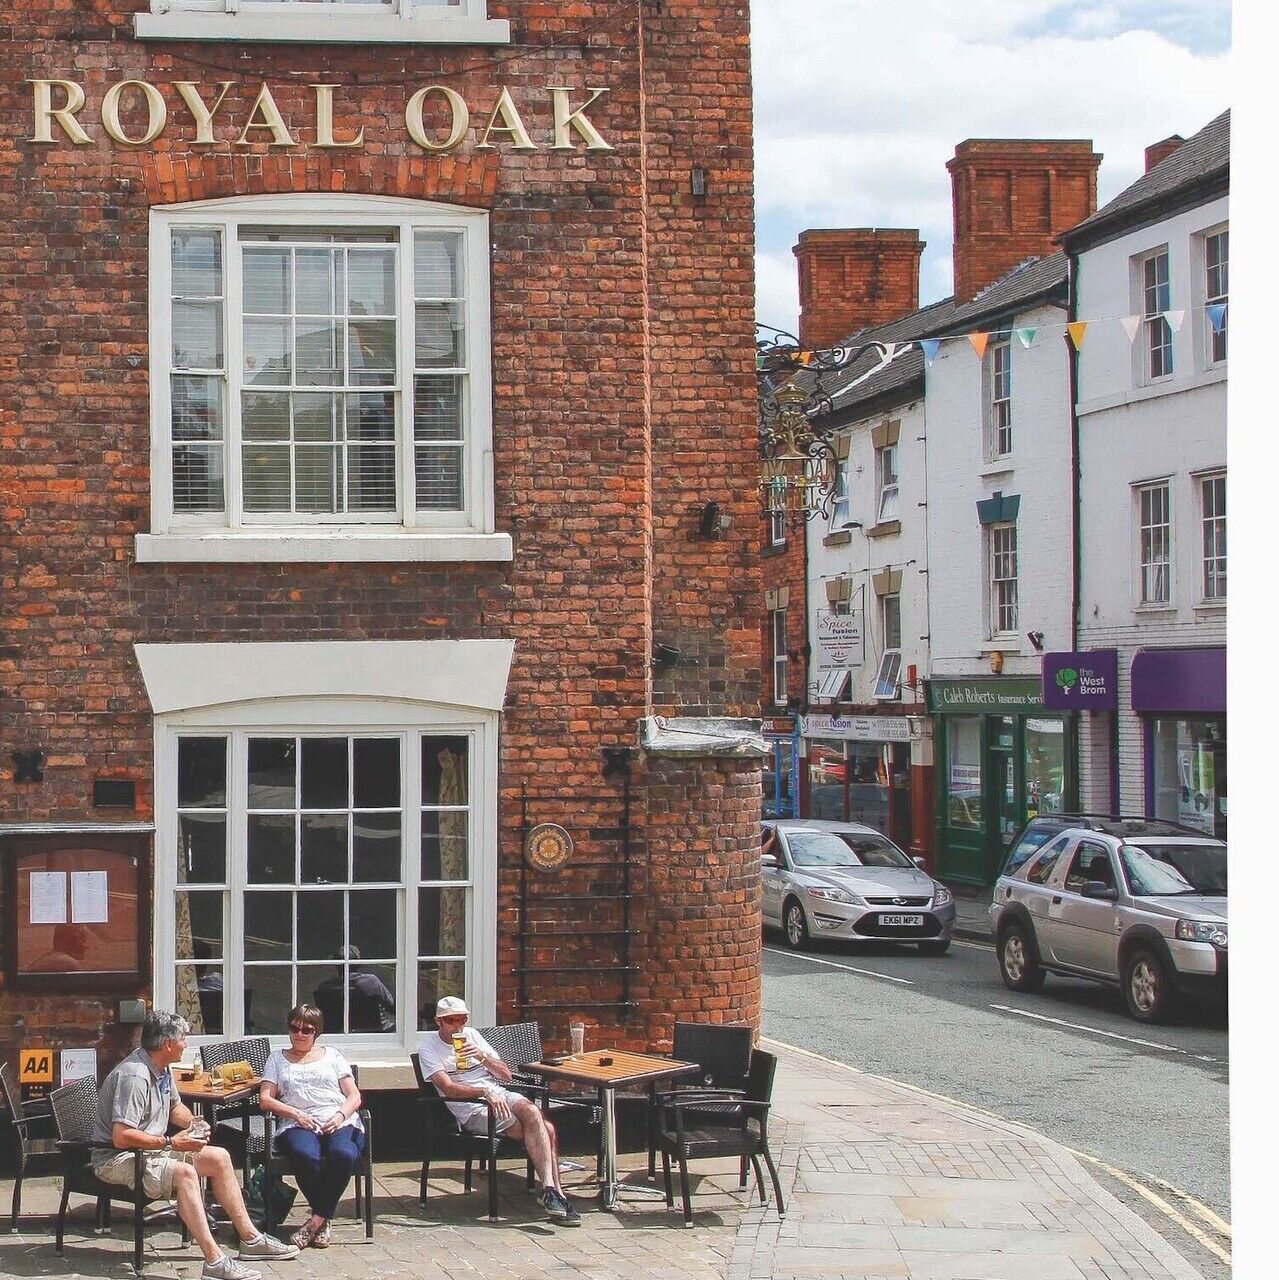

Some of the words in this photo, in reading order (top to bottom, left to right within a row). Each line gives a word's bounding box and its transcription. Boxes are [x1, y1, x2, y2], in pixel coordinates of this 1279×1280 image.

[26, 79, 364, 147] ROYAL
[405, 85, 615, 150] OAK
[820, 617, 854, 630] Spice
[1079, 668, 1094, 676] the
[1080, 677, 1105, 685] West
[943, 688, 964, 704] Caleb
[965, 687, 995, 704] Roberts
[997, 694, 1026, 704] Insurance
[1080, 686, 1106, 694] Brom
[23, 1057, 49, 1073] AA
